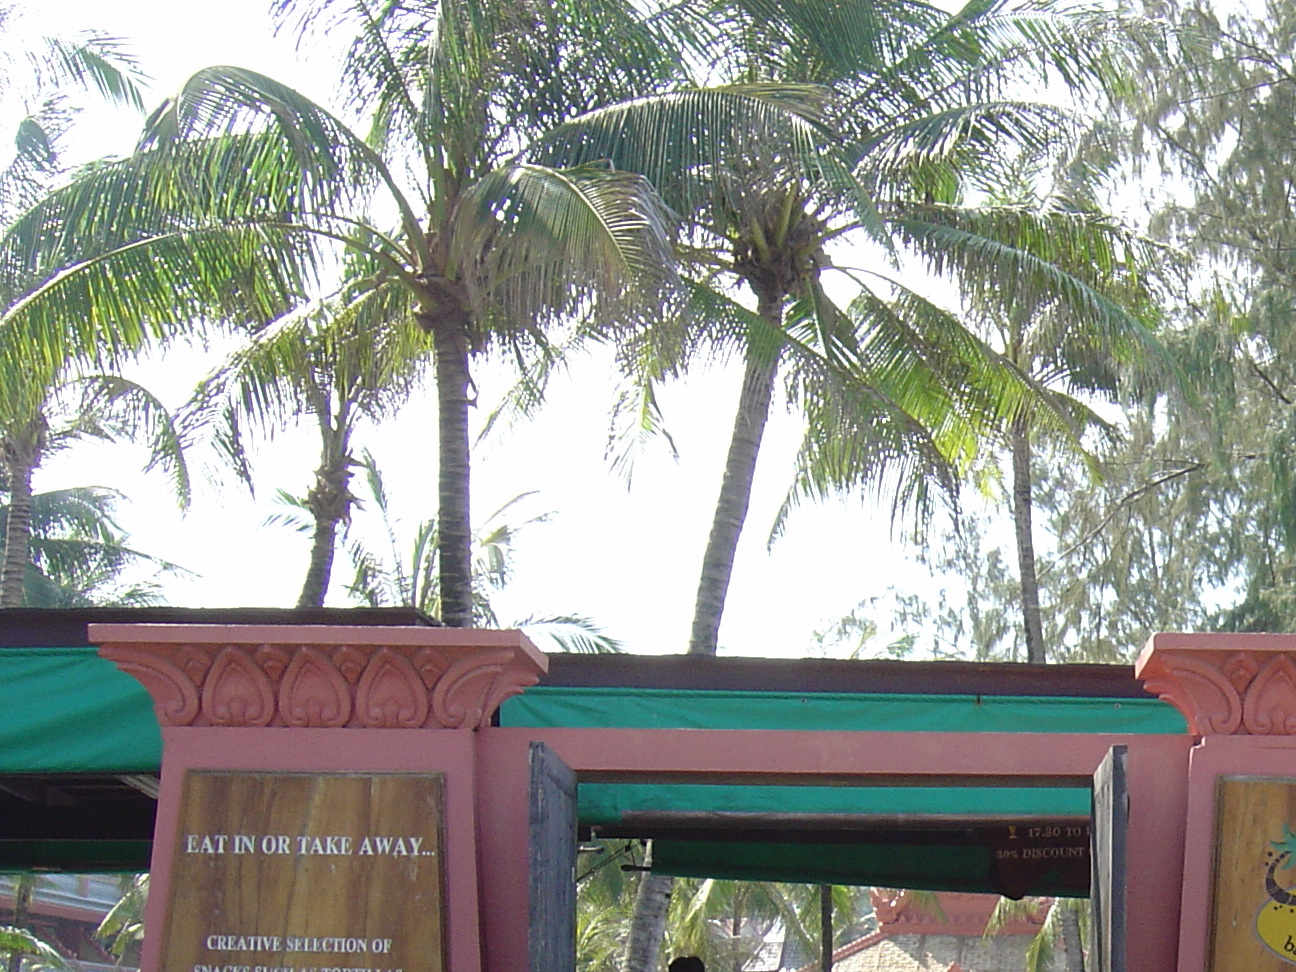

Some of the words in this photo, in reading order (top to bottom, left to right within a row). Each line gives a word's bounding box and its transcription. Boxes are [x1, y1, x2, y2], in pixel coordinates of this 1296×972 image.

[187, 835, 228, 853] EAT
[234, 835, 255, 854] IN
[261, 835, 290, 855] OR
[297, 836, 352, 855] TAKE
[1022, 847, 1084, 859] DISCOUNT
[206, 935, 282, 952] CREATIVE
[286, 937, 367, 953] SELECTION
[372, 938, 392, 953] OF
